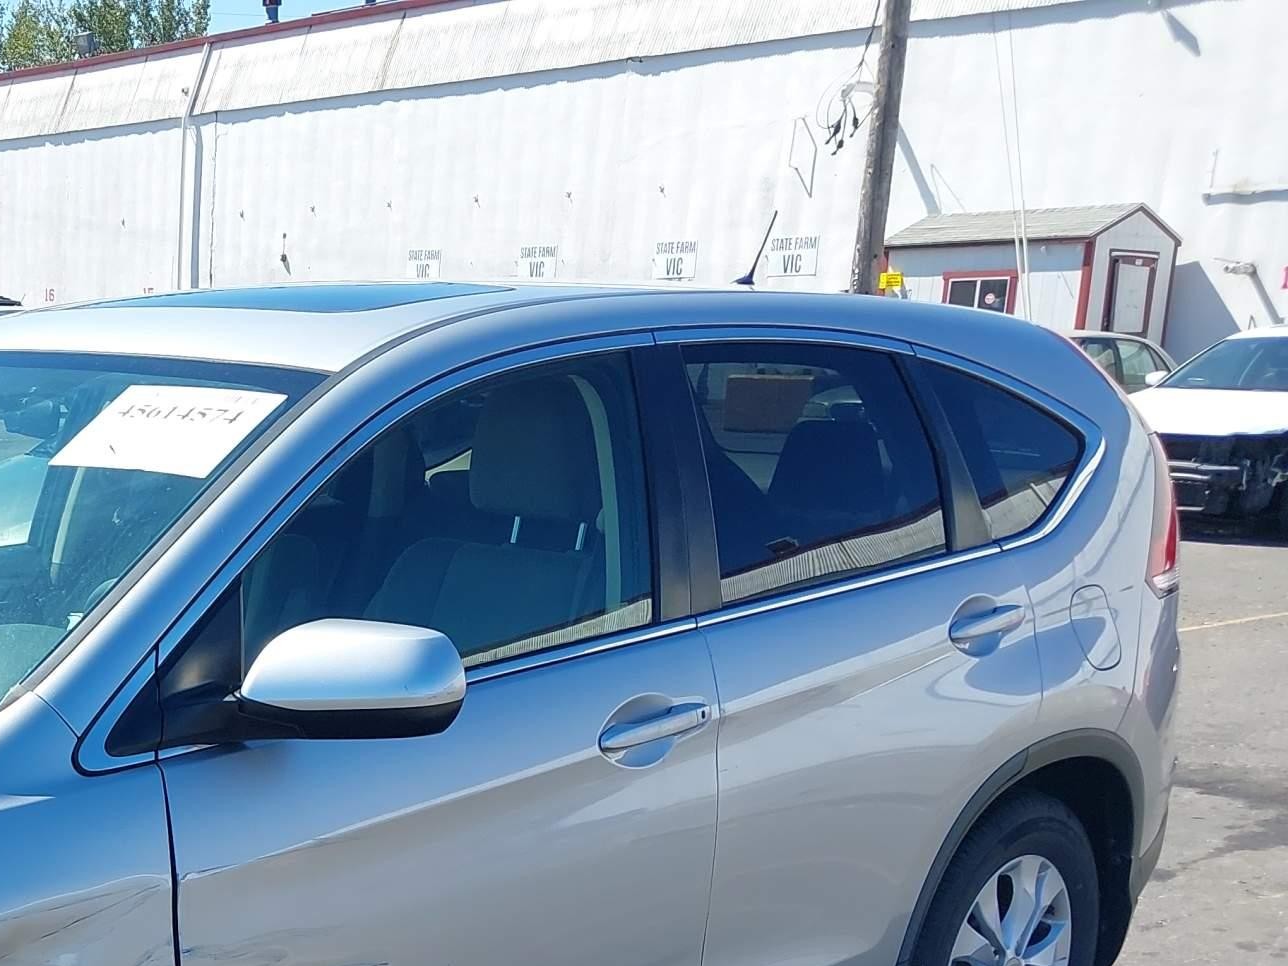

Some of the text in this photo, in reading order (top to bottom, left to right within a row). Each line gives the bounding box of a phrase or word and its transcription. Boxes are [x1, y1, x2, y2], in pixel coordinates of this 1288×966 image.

[656, 241, 696, 255] STATE FARM
[771, 237, 817, 251] STATE FARM
[408, 249, 440, 261] STATE FARM
[520, 246, 556, 259] STATE FARM
[416, 263, 430, 278] VIC
[528, 261, 545, 278] VIC
[666, 257, 683, 276] VIC
[782, 254, 802, 273] VIC
[44, 288, 55, 302] 16
